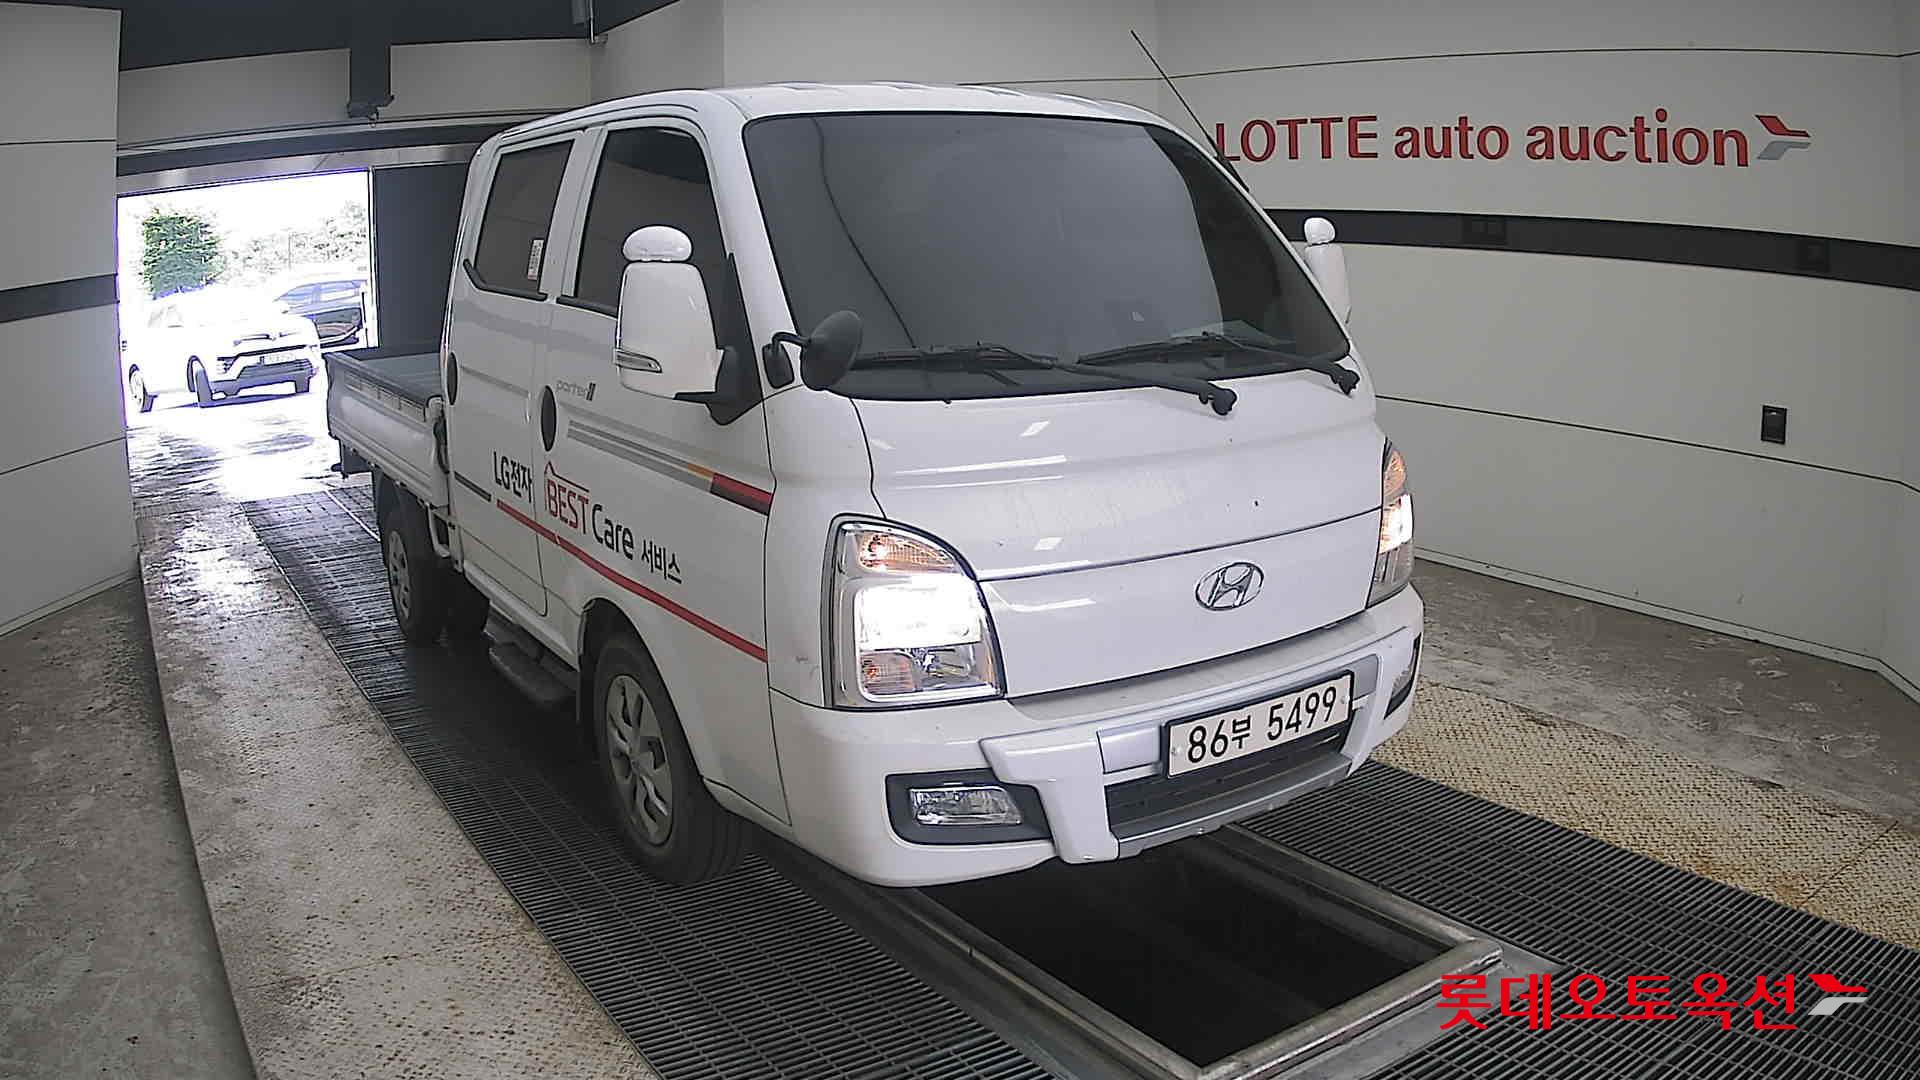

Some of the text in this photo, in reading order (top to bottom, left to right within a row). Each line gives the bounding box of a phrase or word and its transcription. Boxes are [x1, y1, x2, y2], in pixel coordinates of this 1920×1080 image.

[1215, 107, 1749, 168] LOTTE auto auction
[493, 451, 682, 584] LG전자 BEST Care 서비스
[1187, 686, 1337, 763] 86부 5499
